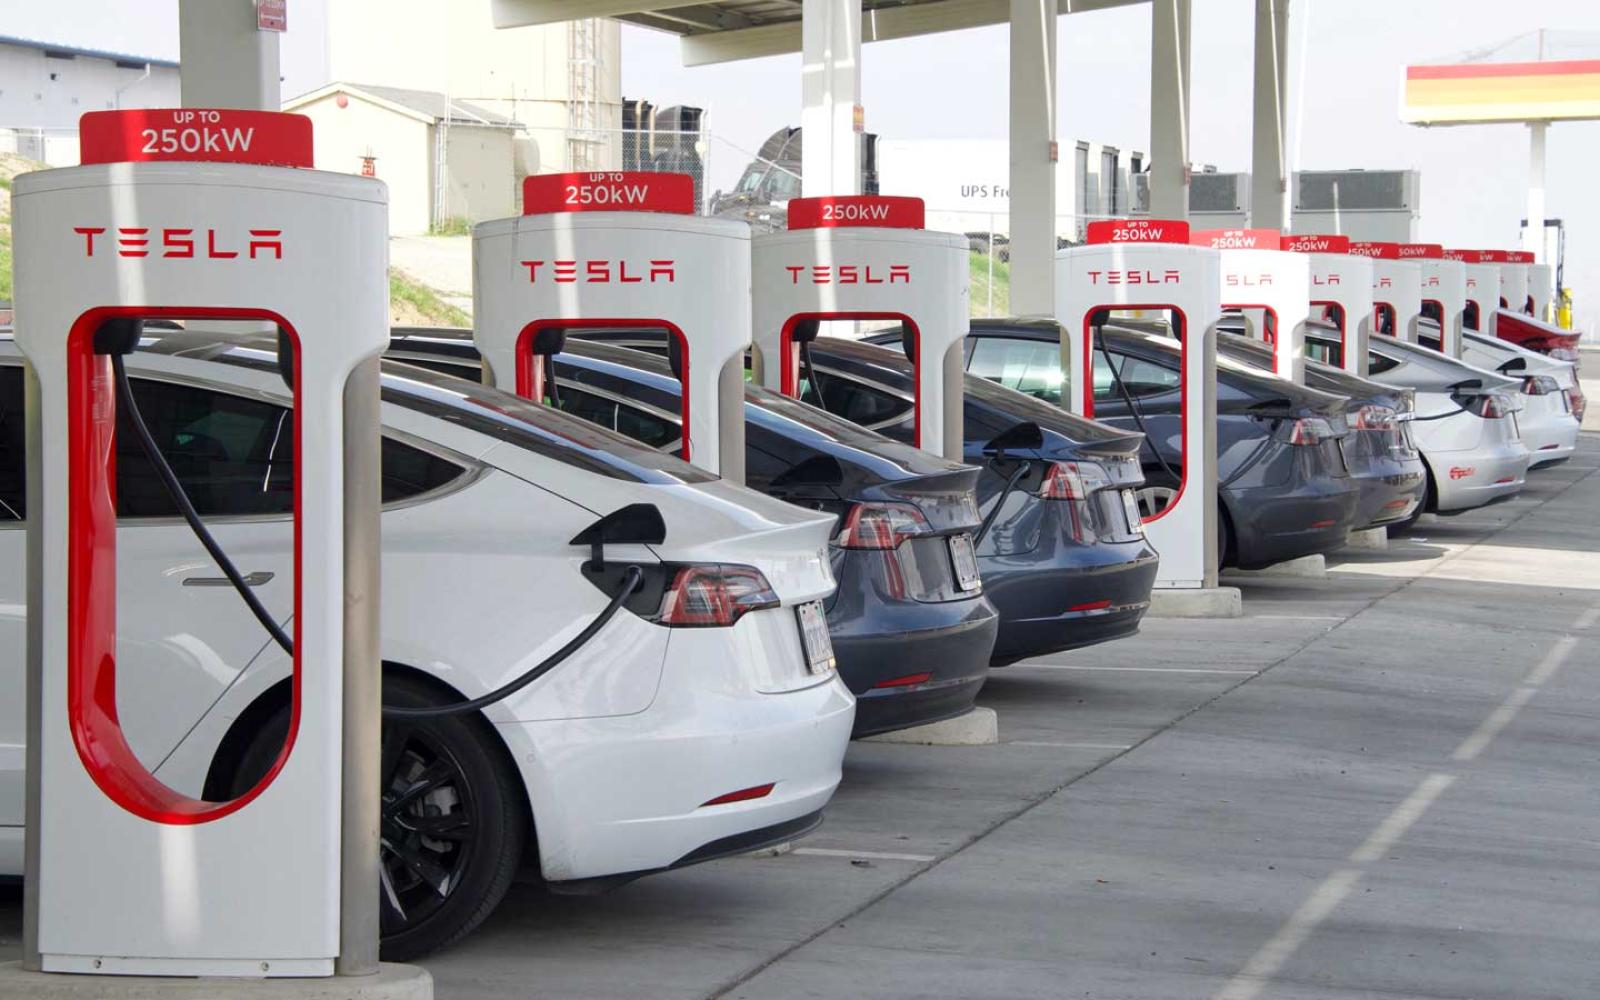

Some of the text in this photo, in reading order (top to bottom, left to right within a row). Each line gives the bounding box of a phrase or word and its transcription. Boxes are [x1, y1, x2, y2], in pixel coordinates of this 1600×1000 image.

[173, 111, 220, 123] UP TO
[141, 128, 254, 153] 250kW
[589, 173, 624, 182] UP TO
[565, 185, 648, 204] 250kW
[961, 185, 988, 198] UPS
[822, 204, 889, 220] 250kW
[1112, 228, 1163, 241] 250kW
[73, 227, 282, 259] TESLA
[1211, 237, 1256, 249] 250kW
[1289, 240, 1329, 252] 250kW
[520, 260, 675, 283] TESLA
[785, 265, 910, 284] TESLA
[1087, 270, 1180, 285] TESLA
[1226, 274, 1273, 286] SLA
